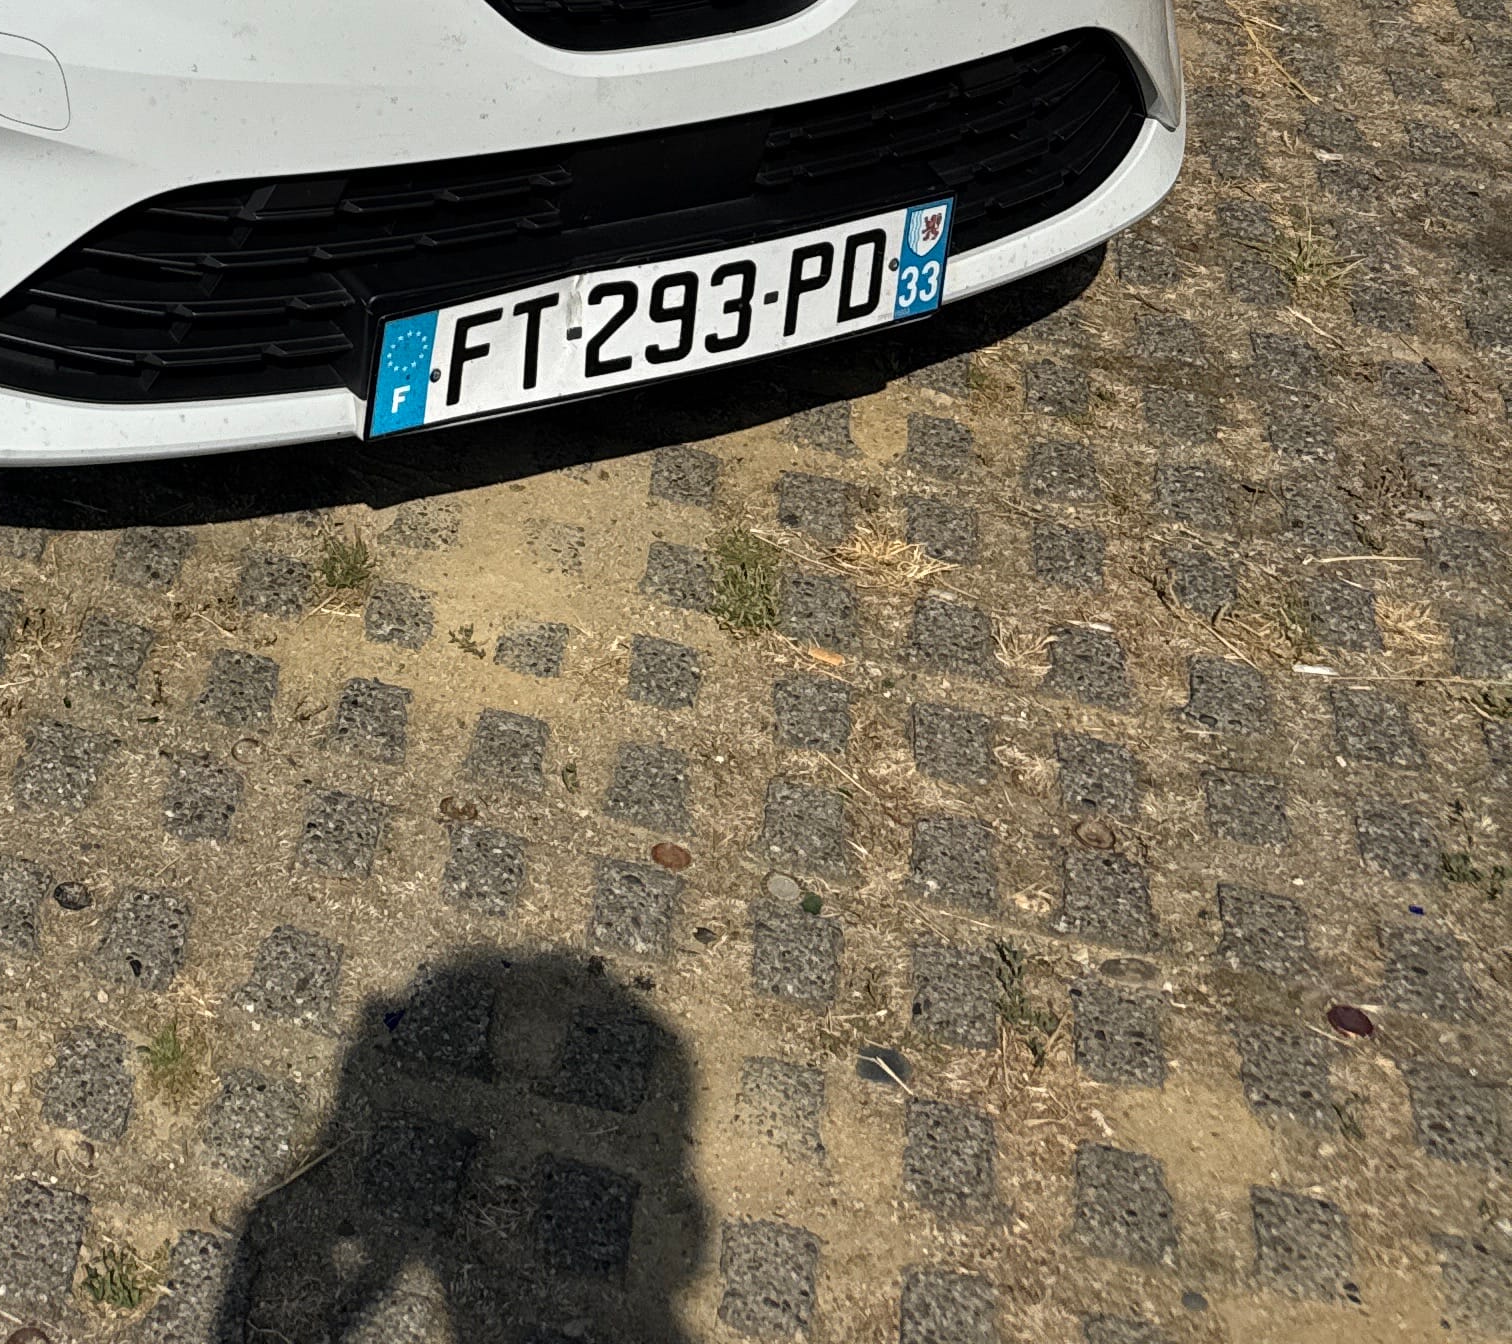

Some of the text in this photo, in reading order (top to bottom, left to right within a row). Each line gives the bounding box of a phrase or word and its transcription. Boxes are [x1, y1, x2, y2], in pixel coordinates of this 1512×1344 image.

[898, 260, 940, 308] 33
[445, 227, 888, 407] FT-293-PD
[391, 385, 411, 413] F
